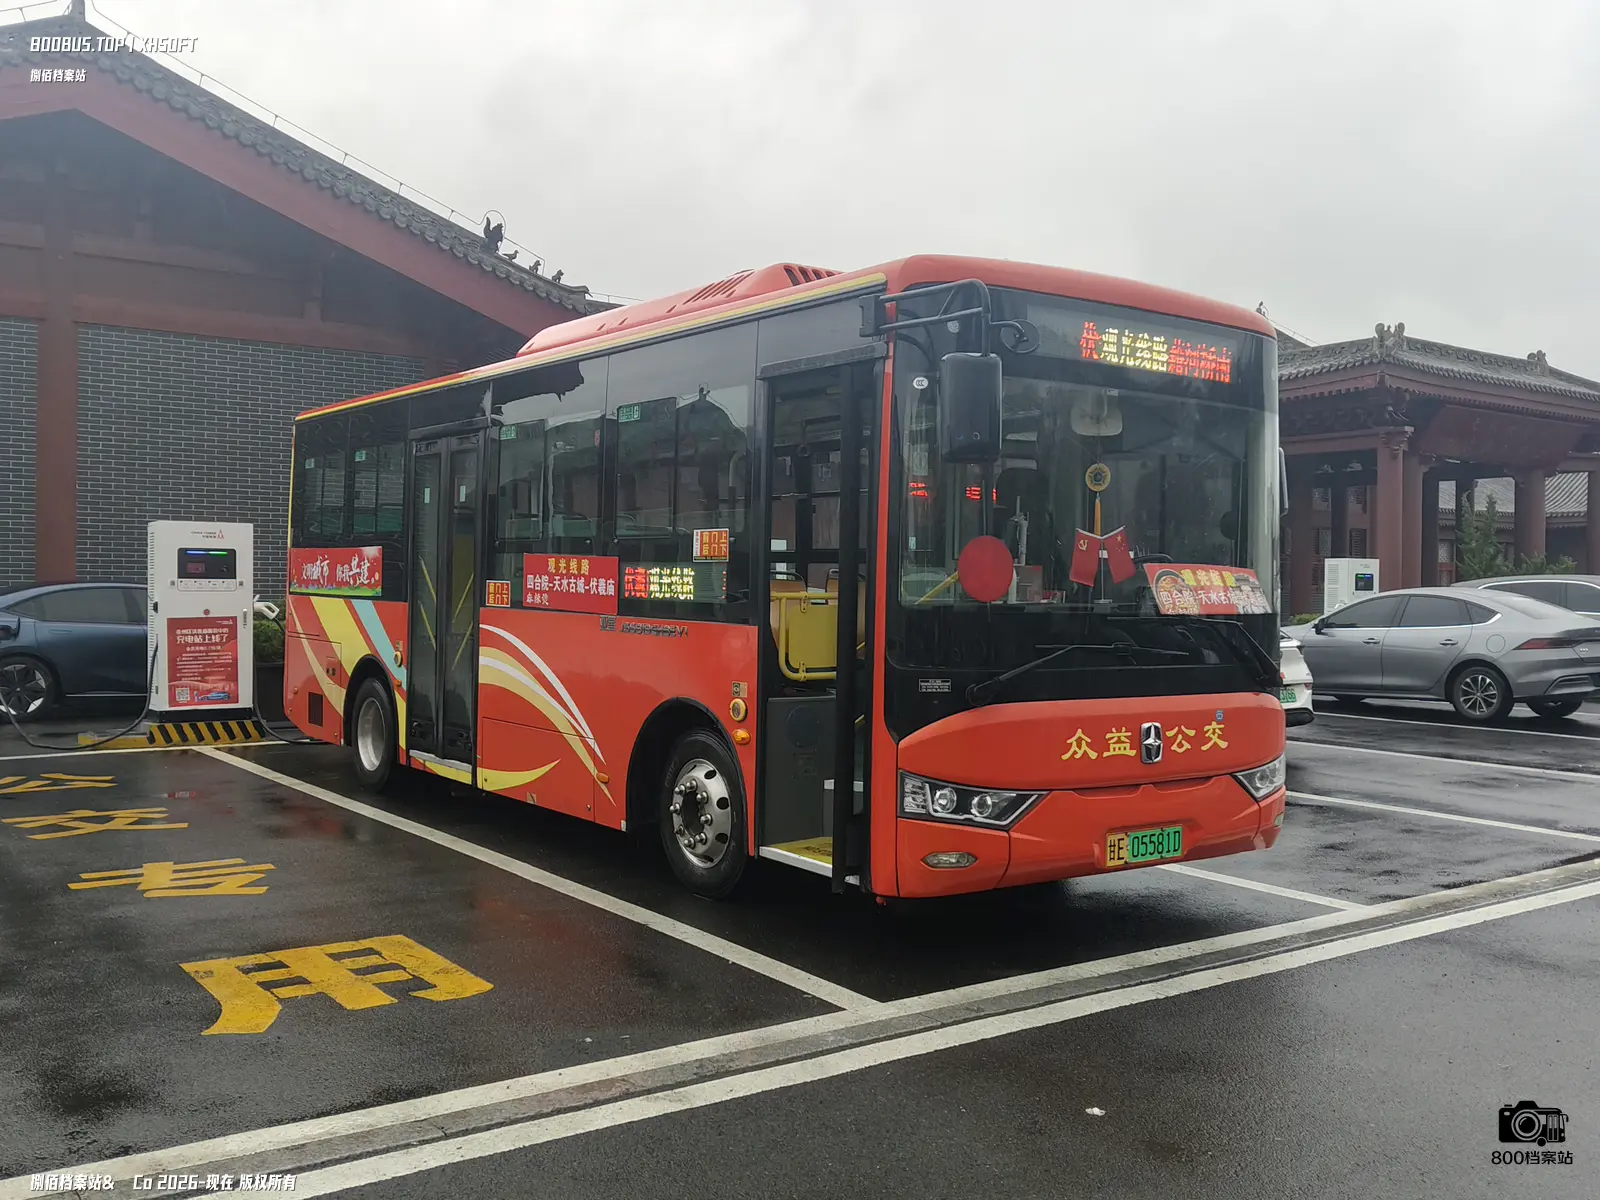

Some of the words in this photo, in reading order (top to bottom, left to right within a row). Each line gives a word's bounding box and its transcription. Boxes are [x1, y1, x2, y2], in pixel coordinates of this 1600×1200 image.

[702, 531, 727, 543] 前门上
[702, 543, 727, 556] 后门下
[547, 557, 590, 576] 观光线路
[1061, 727, 1137, 761] 众益
[1165, 721, 1229, 753] 公交
[1108, 837, 1126, 862] 甘E
[1131, 829, 1182, 858] 05581D
